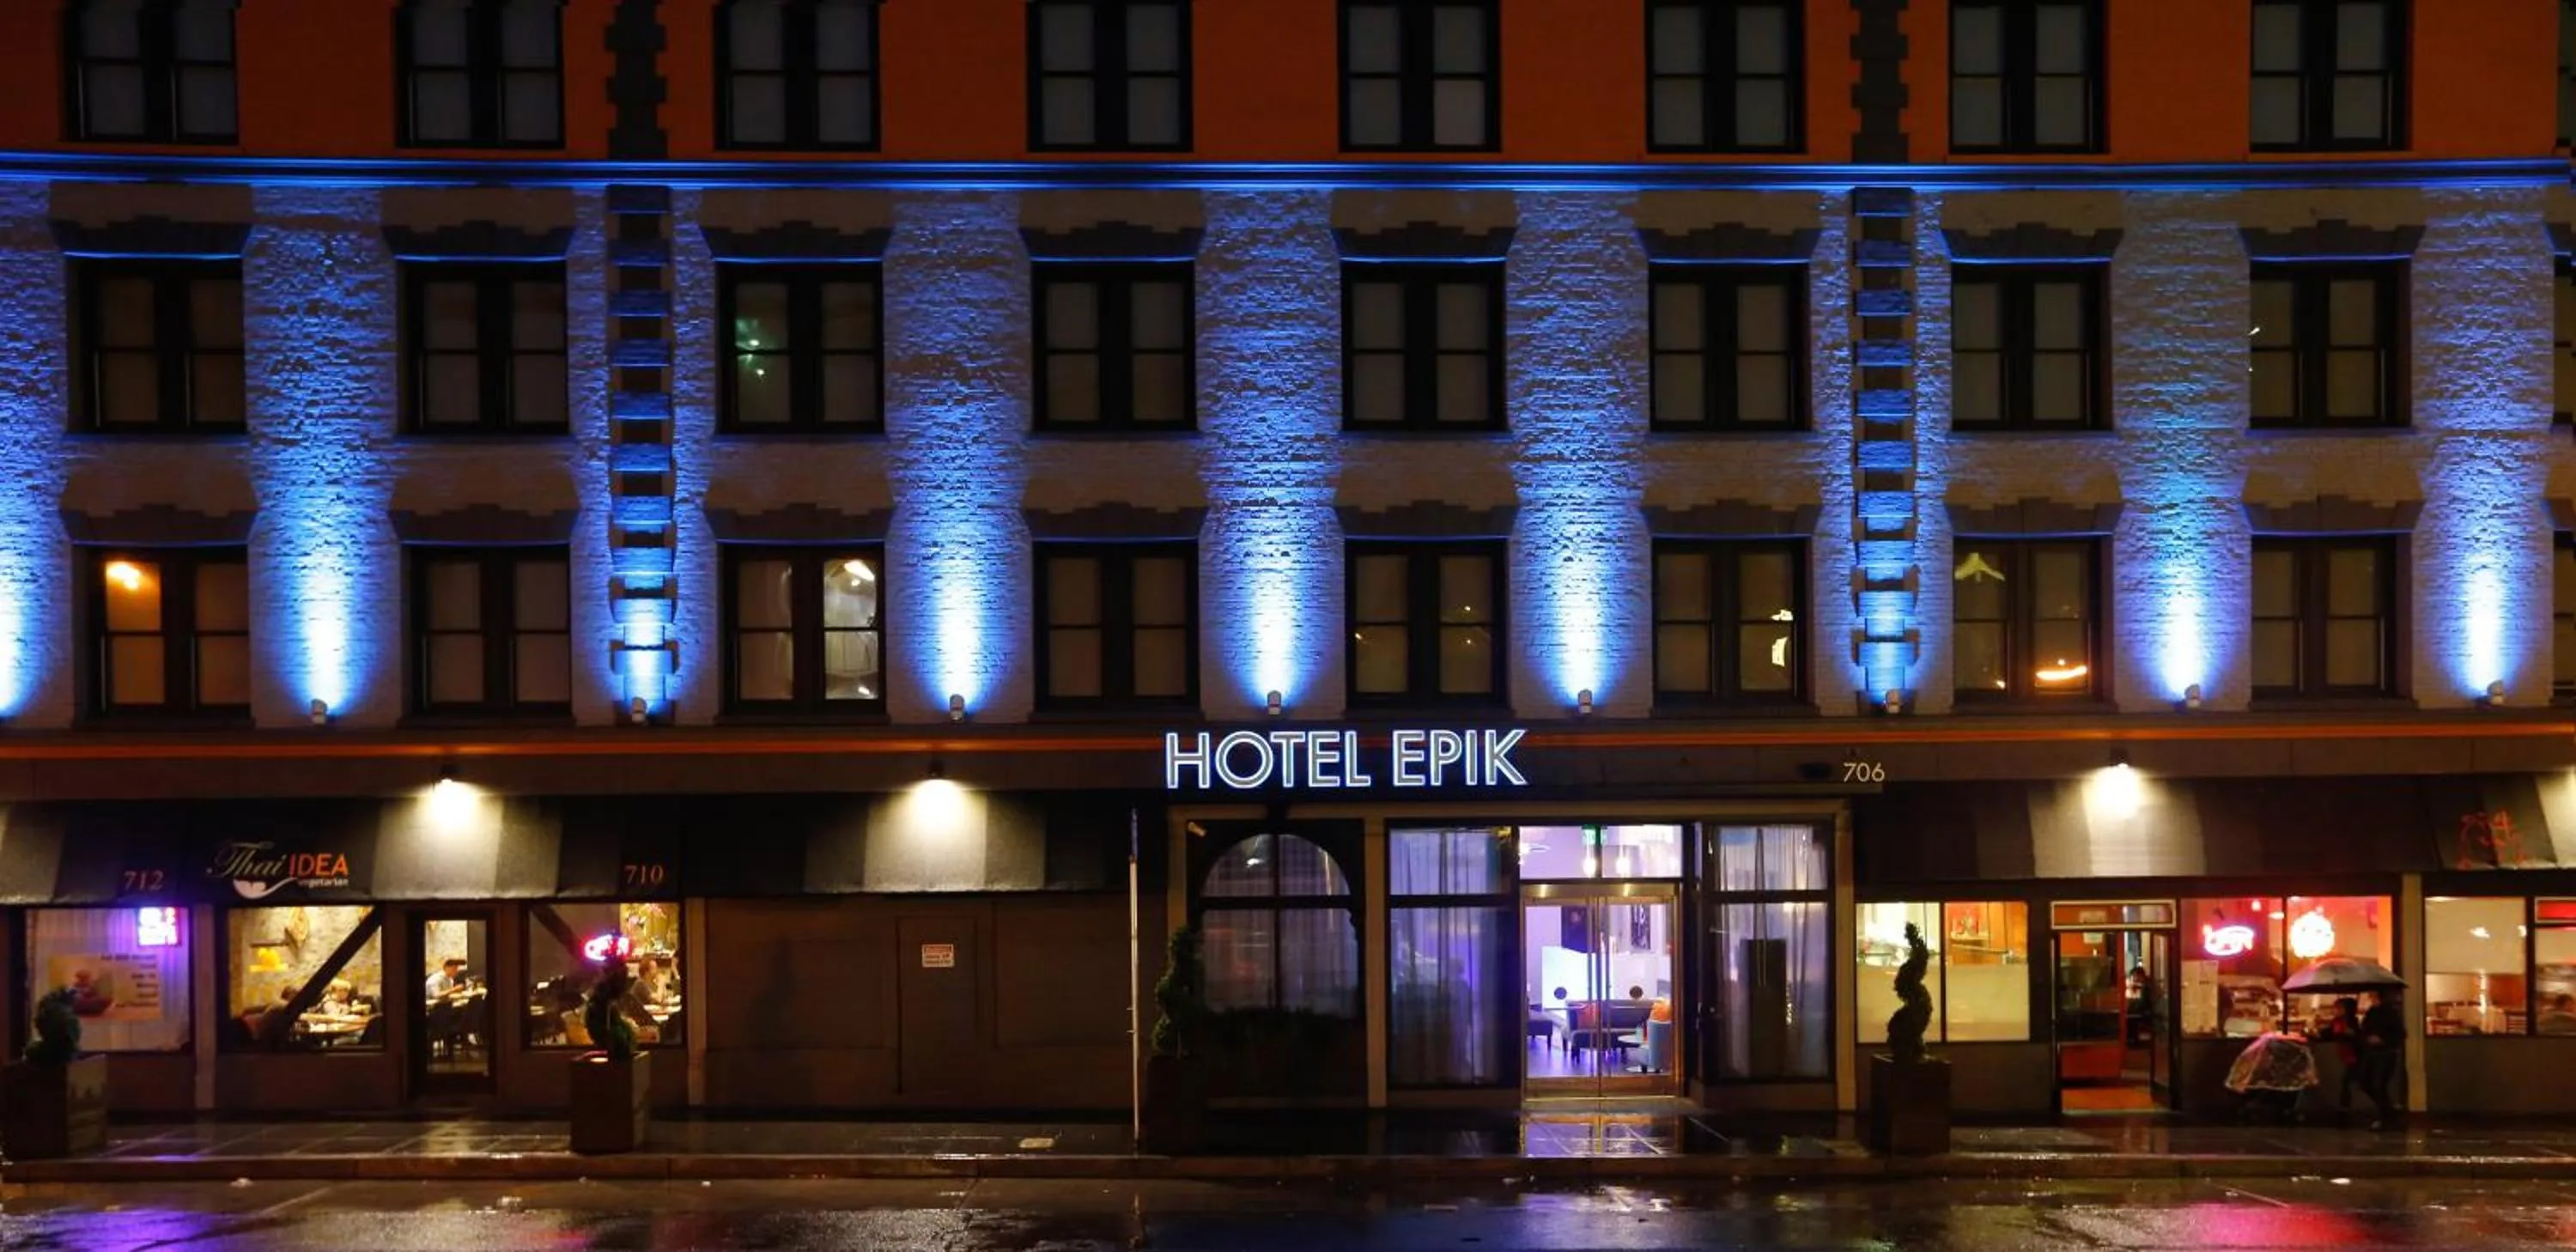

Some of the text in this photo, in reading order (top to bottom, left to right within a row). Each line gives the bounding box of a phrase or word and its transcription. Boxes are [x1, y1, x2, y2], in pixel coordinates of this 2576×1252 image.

[1166, 729, 1528, 788] HOTEL EPIK
[1843, 762, 1886, 783] 706
[207, 842, 349, 877] Thai IDEA
[124, 869, 165, 891] 712
[624, 864, 664, 884] 710
